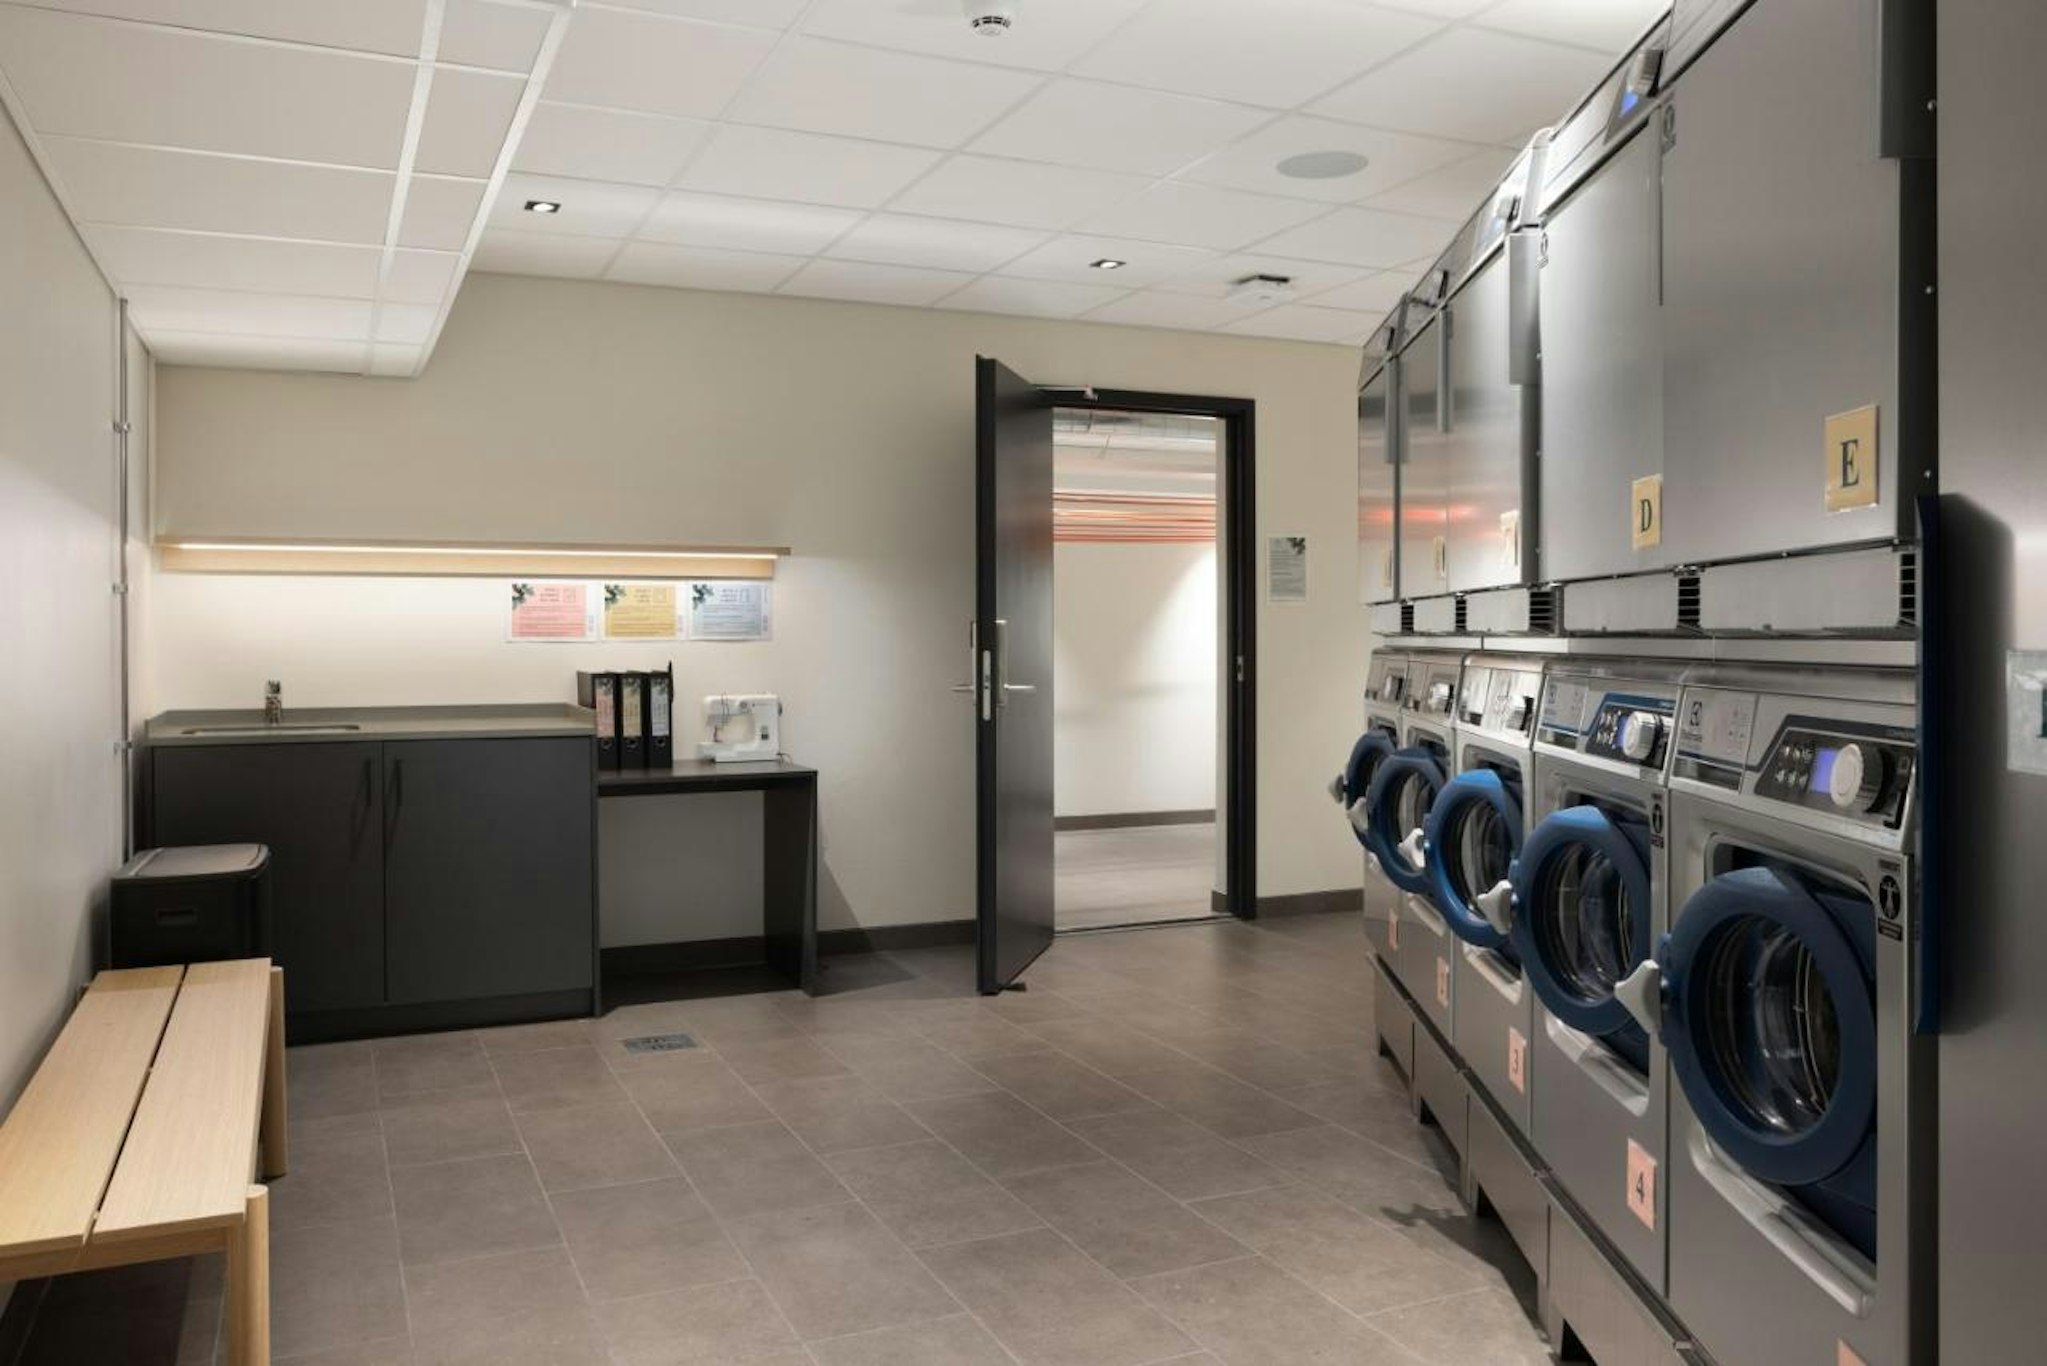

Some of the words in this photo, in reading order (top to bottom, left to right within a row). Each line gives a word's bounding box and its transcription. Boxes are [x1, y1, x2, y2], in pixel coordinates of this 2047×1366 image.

[1840, 439, 1859, 488] E
[1640, 499, 1652, 533] D
[1512, 1048, 1519, 1075] 3
[1636, 1171, 1645, 1204] 4
